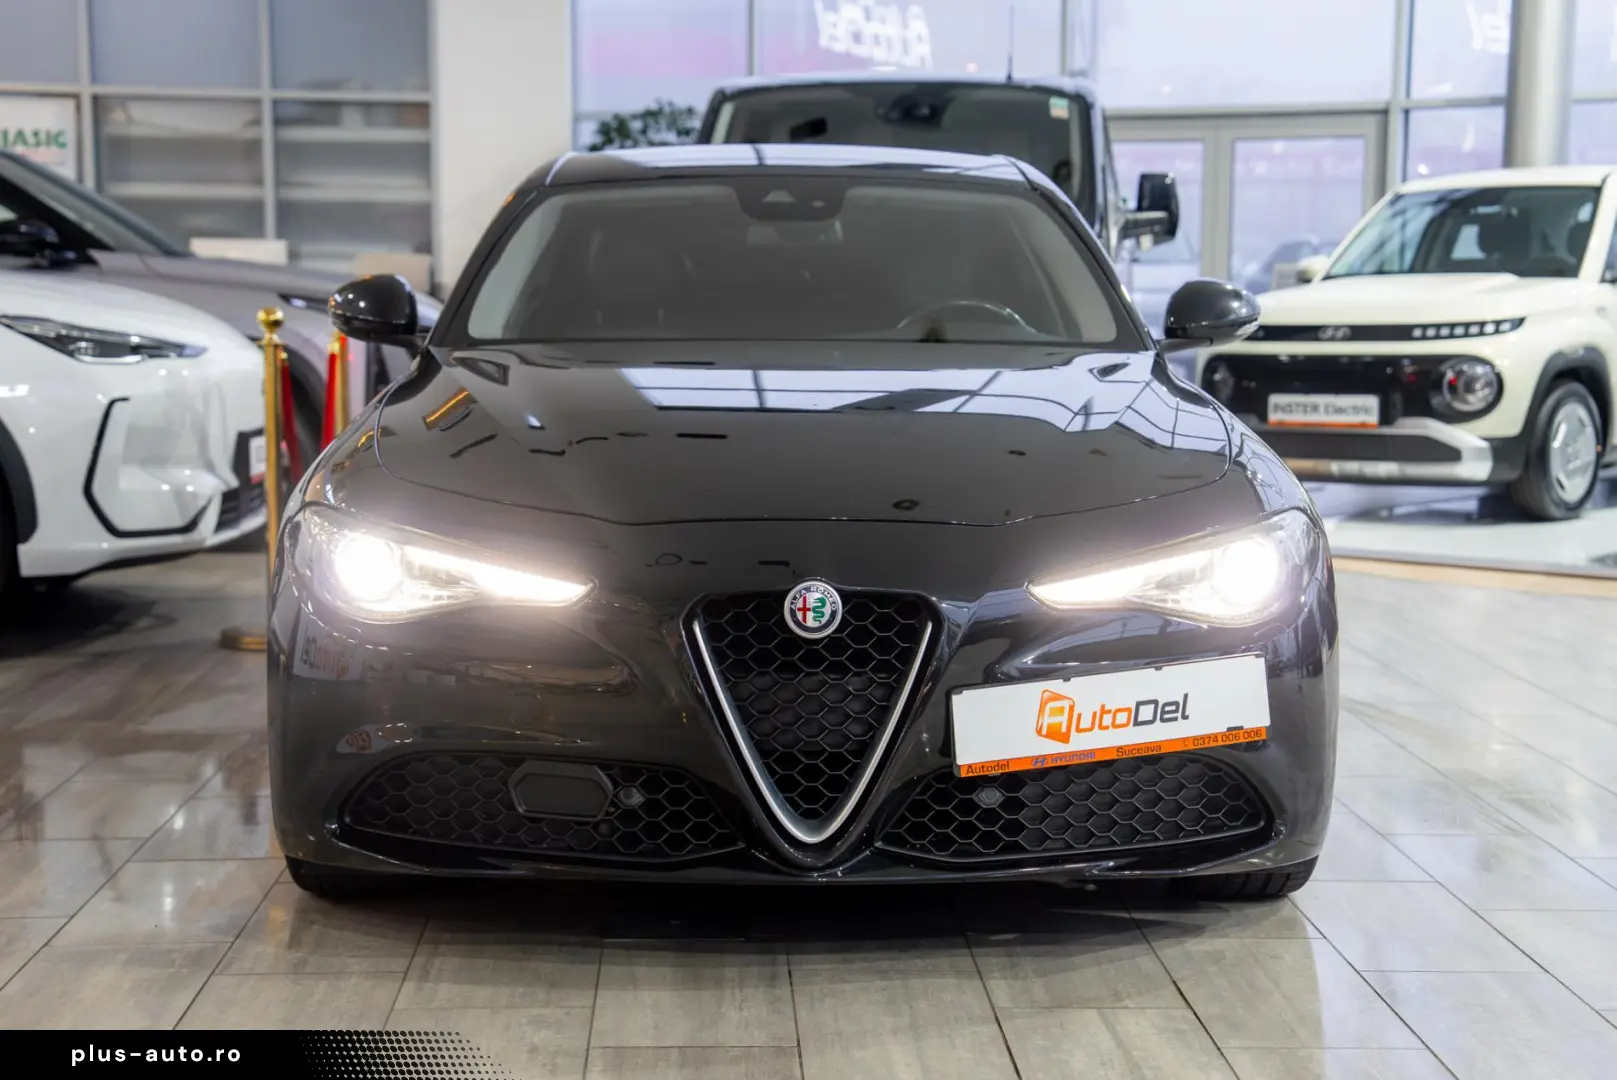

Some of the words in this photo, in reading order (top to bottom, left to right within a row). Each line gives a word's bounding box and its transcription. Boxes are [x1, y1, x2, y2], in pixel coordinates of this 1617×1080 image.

[790, 589, 807, 610] ALFA
[810, 586, 837, 611] ROMEO
[1036, 689, 1190, 744] AutoDel
[966, 760, 1010, 775] Autodel
[1050, 751, 1096, 763] HYUNDAI
[1116, 744, 1162, 757] Suceava
[1192, 735, 1219, 747] 0374
[1221, 732, 1241, 742] 006
[1243, 728, 1262, 740] 006
